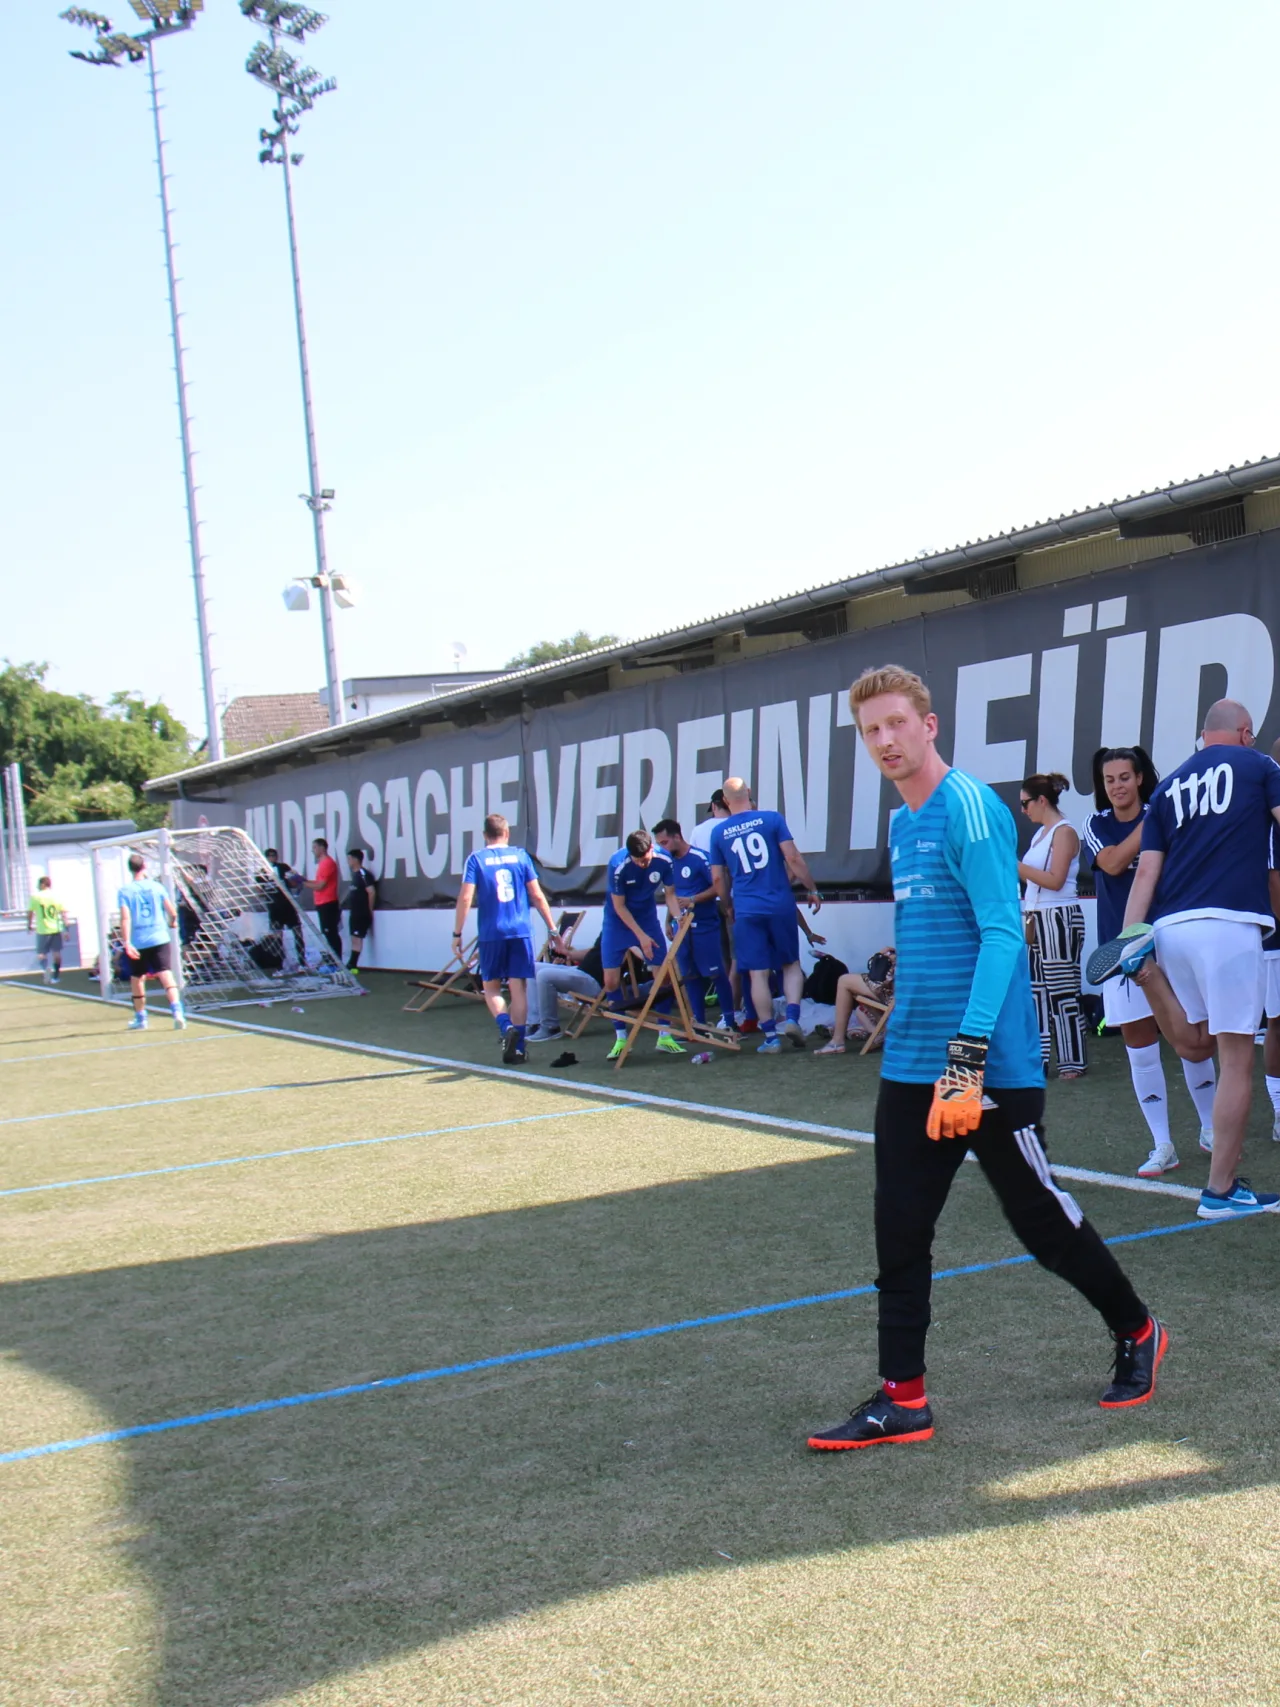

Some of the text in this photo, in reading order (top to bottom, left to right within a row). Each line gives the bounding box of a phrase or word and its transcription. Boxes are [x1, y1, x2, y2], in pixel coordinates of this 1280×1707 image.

[281, 790, 352, 882] DER
[357, 755, 520, 882] SACHE
[952, 595, 1275, 840] FÜR
[723, 818, 764, 836] ASKLEPIOS
[731, 832, 769, 873] 19
[40, 904, 57, 919] 10
[140, 900, 152, 919] 5
